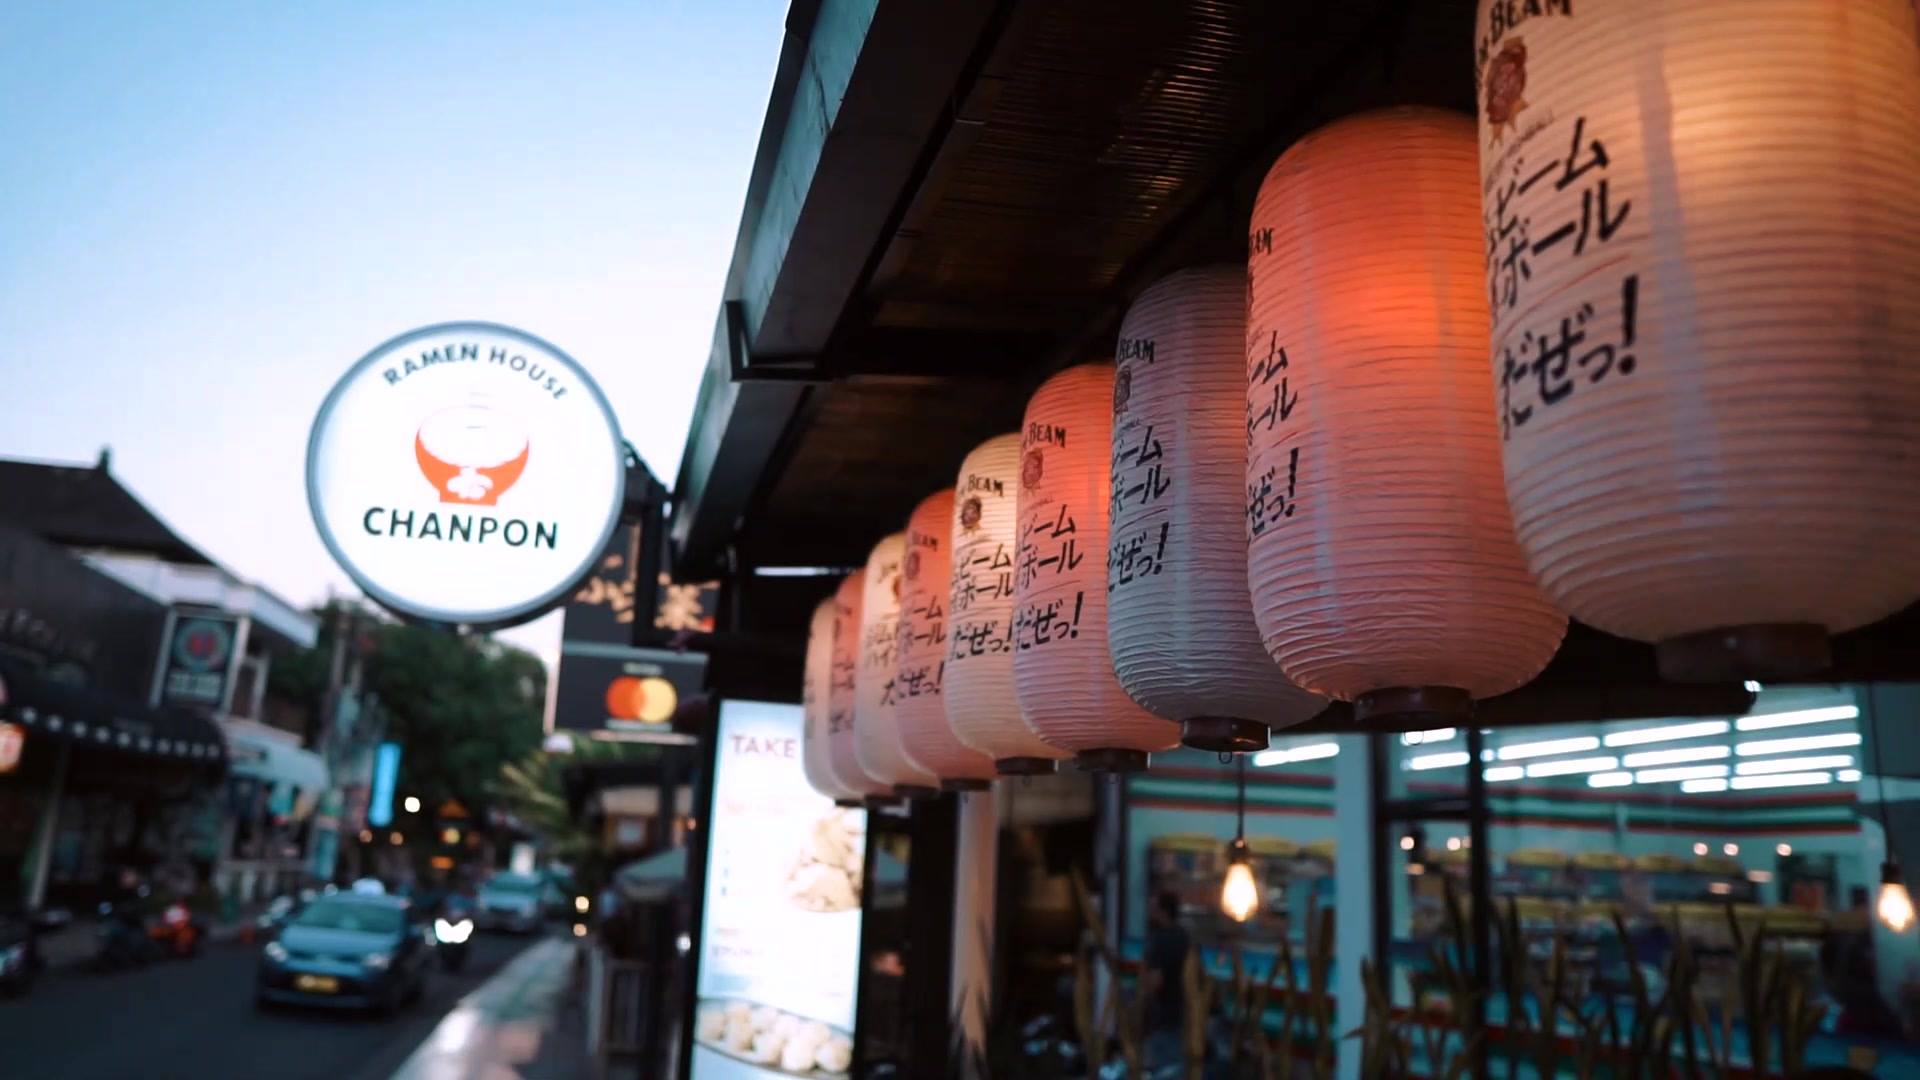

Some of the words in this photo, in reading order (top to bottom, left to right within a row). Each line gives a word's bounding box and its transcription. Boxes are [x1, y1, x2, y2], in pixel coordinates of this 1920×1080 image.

[382, 343, 479, 386] RAMEN
[488, 345, 568, 400] HOUSE
[1028, 421, 1067, 449] BEAM
[968, 473, 1004, 497] BEAM
[363, 507, 558, 550] CHANPON
[730, 734, 797, 758] TAKE
